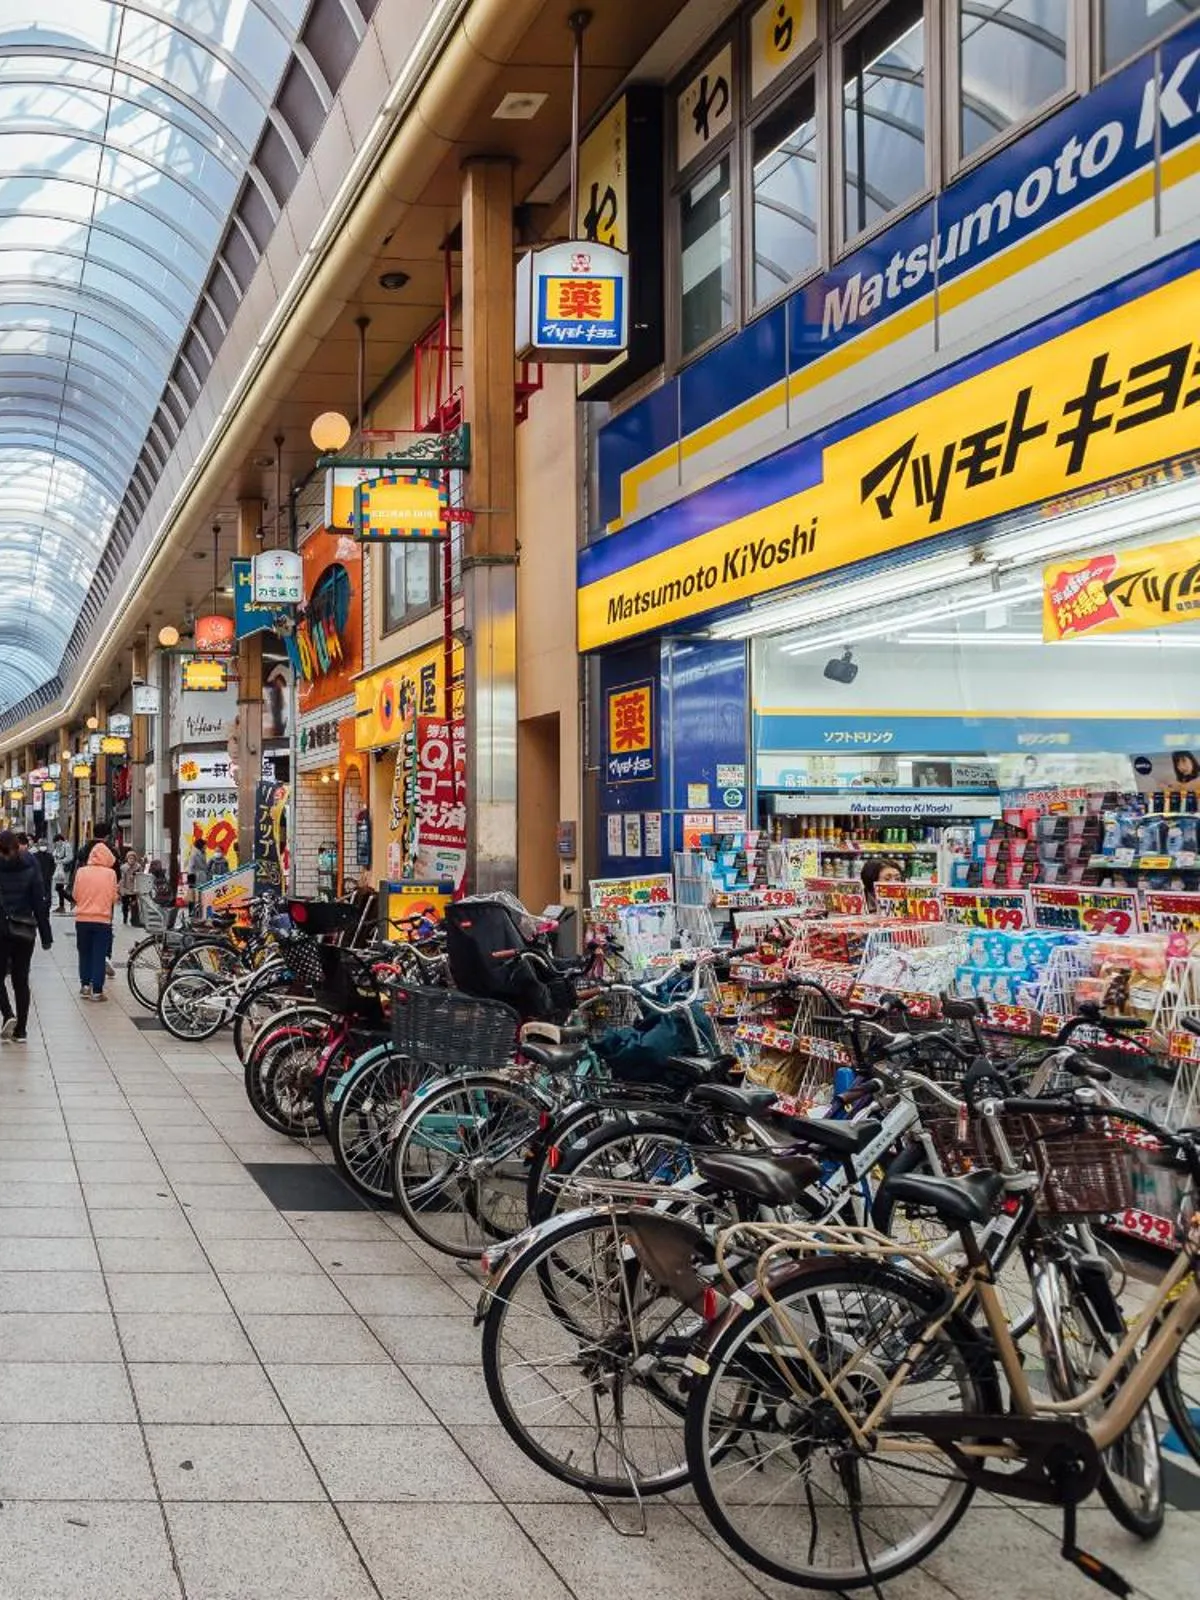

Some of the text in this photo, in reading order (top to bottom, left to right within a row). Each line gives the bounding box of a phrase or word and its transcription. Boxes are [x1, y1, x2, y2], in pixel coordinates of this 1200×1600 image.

[692, 75, 729, 141] わ
[821, 48, 1200, 341] Matsumoto K
[558, 281, 602, 319] 薬
[607, 516, 818, 625] Matsumoto KiYoshi
[614, 691, 646, 749] 薬
[823, 732, 894, 743] ソフトドリンク
[850, 803, 953, 813] Matsumoto KiYoshi
[984, 908, 1023, 930] 199
[1083, 908, 1132, 935] 99
[1122, 1208, 1172, 1239] 699
